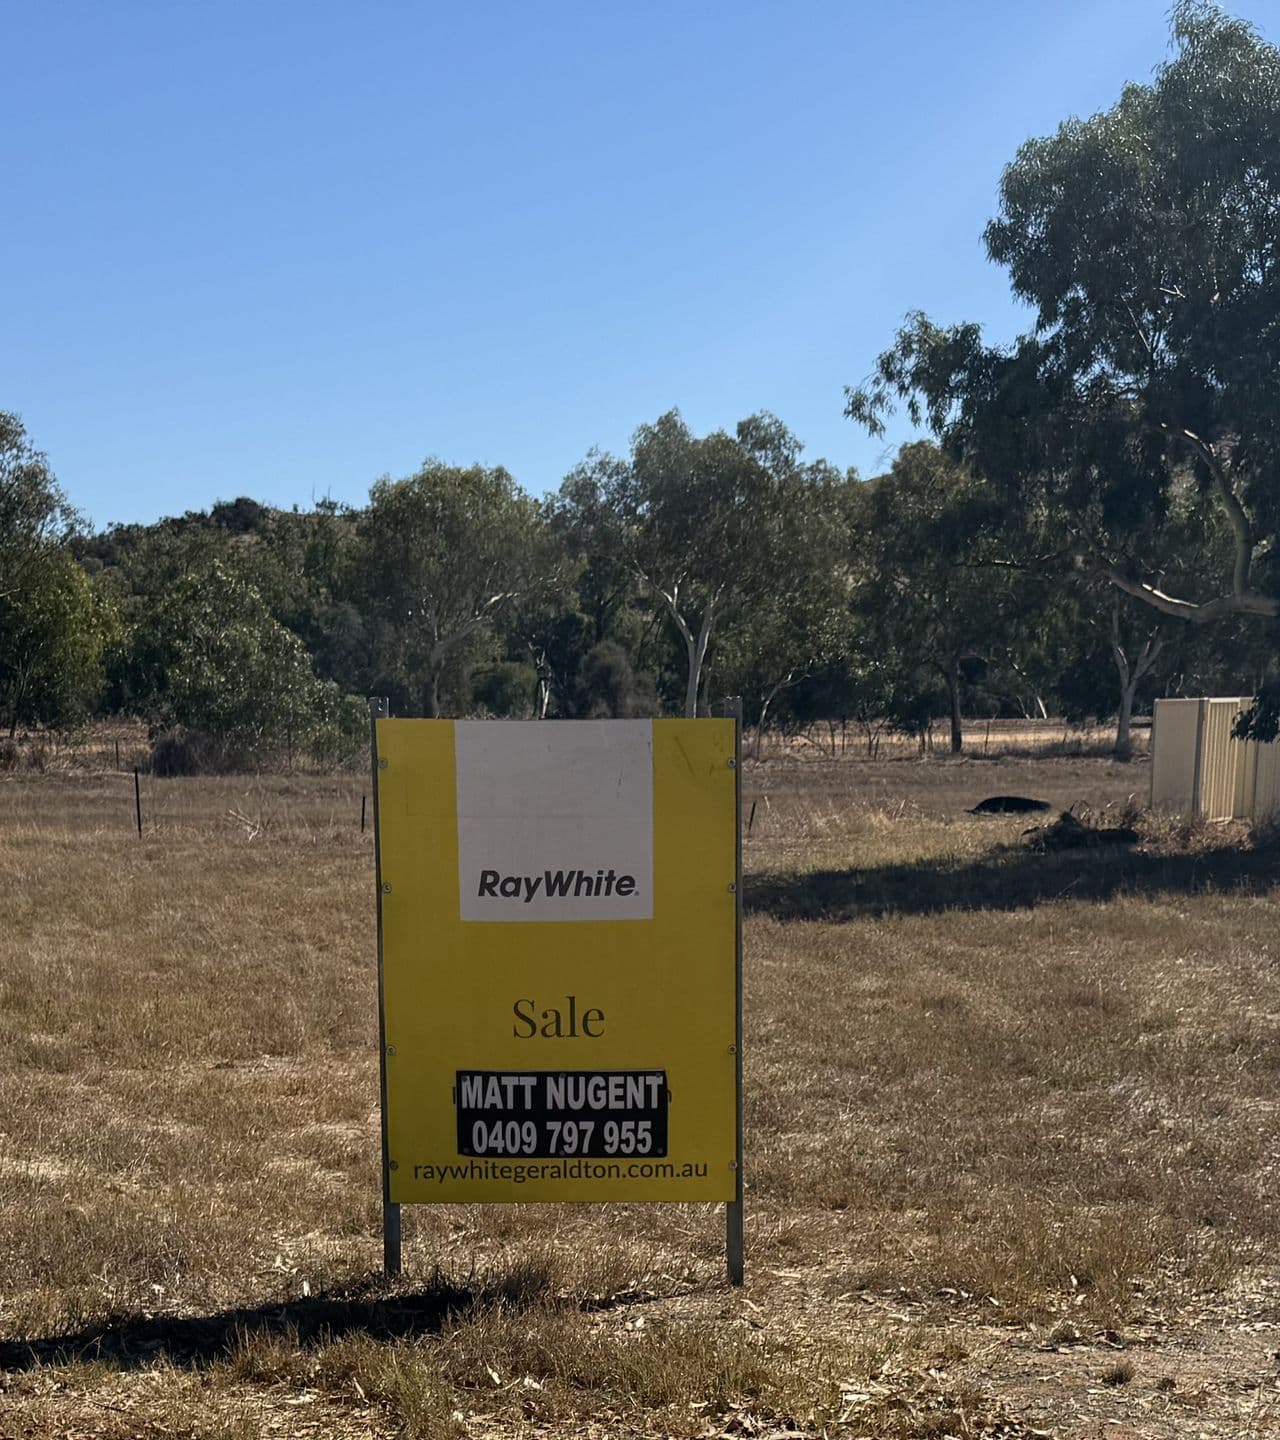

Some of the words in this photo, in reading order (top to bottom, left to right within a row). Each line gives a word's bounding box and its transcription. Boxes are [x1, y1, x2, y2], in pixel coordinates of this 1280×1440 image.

[512, 996, 605, 1039] Sale
[461, 1075, 537, 1109] MATT
[546, 1075, 663, 1109] NUGENT
[472, 1121, 537, 1154] 0409
[546, 1121, 595, 1154] 797
[603, 1121, 653, 1154] 955
[414, 1160, 708, 1183] raywhitegeraldton.com.au
